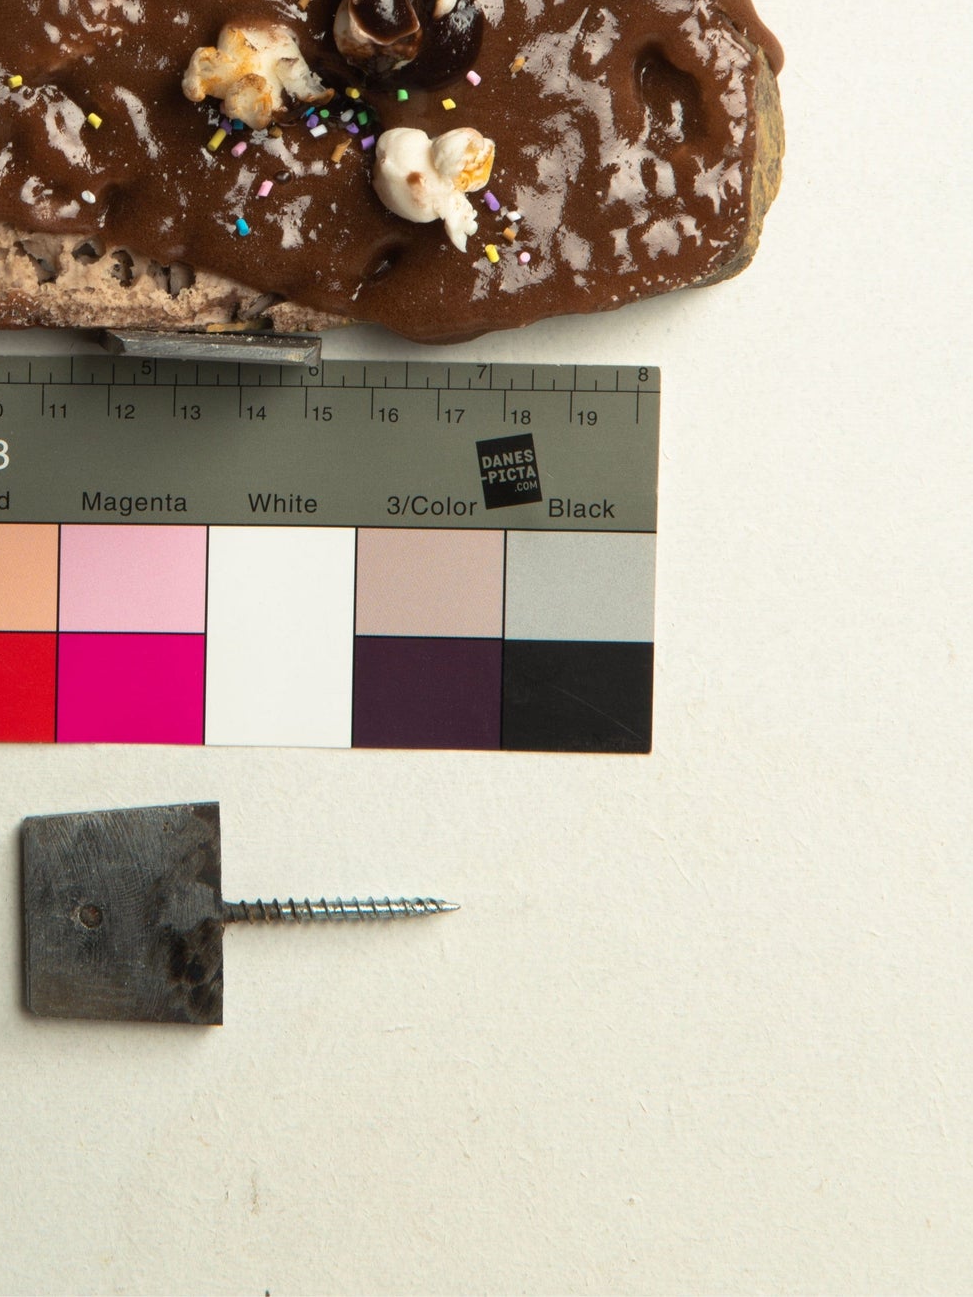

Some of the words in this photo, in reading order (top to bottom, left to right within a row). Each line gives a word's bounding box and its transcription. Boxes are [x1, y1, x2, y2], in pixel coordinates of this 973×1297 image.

[141, 359, 152, 376] 5
[307, 365, 320, 377] 6
[476, 364, 488, 380] 7
[637, 366, 649, 383] 8
[49, 403, 67, 419] 11
[114, 404, 136, 420] 12
[180, 405, 201, 421] 13
[246, 406, 267, 421] 14
[312, 406, 333, 422] 15
[378, 407, 399, 423] 16
[444, 408, 466, 424] 17
[510, 409, 531, 425] 18
[577, 410, 598, 426] 19
[481, 449, 534, 470] DANES
[480, 465, 536, 484] -PICTA
[514, 480, 538, 492] .COM
[82, 491, 188, 517] Magenta
[248, 493, 318, 514] White
[386, 495, 478, 517] 3/Color
[548, 498, 615, 519] Black
